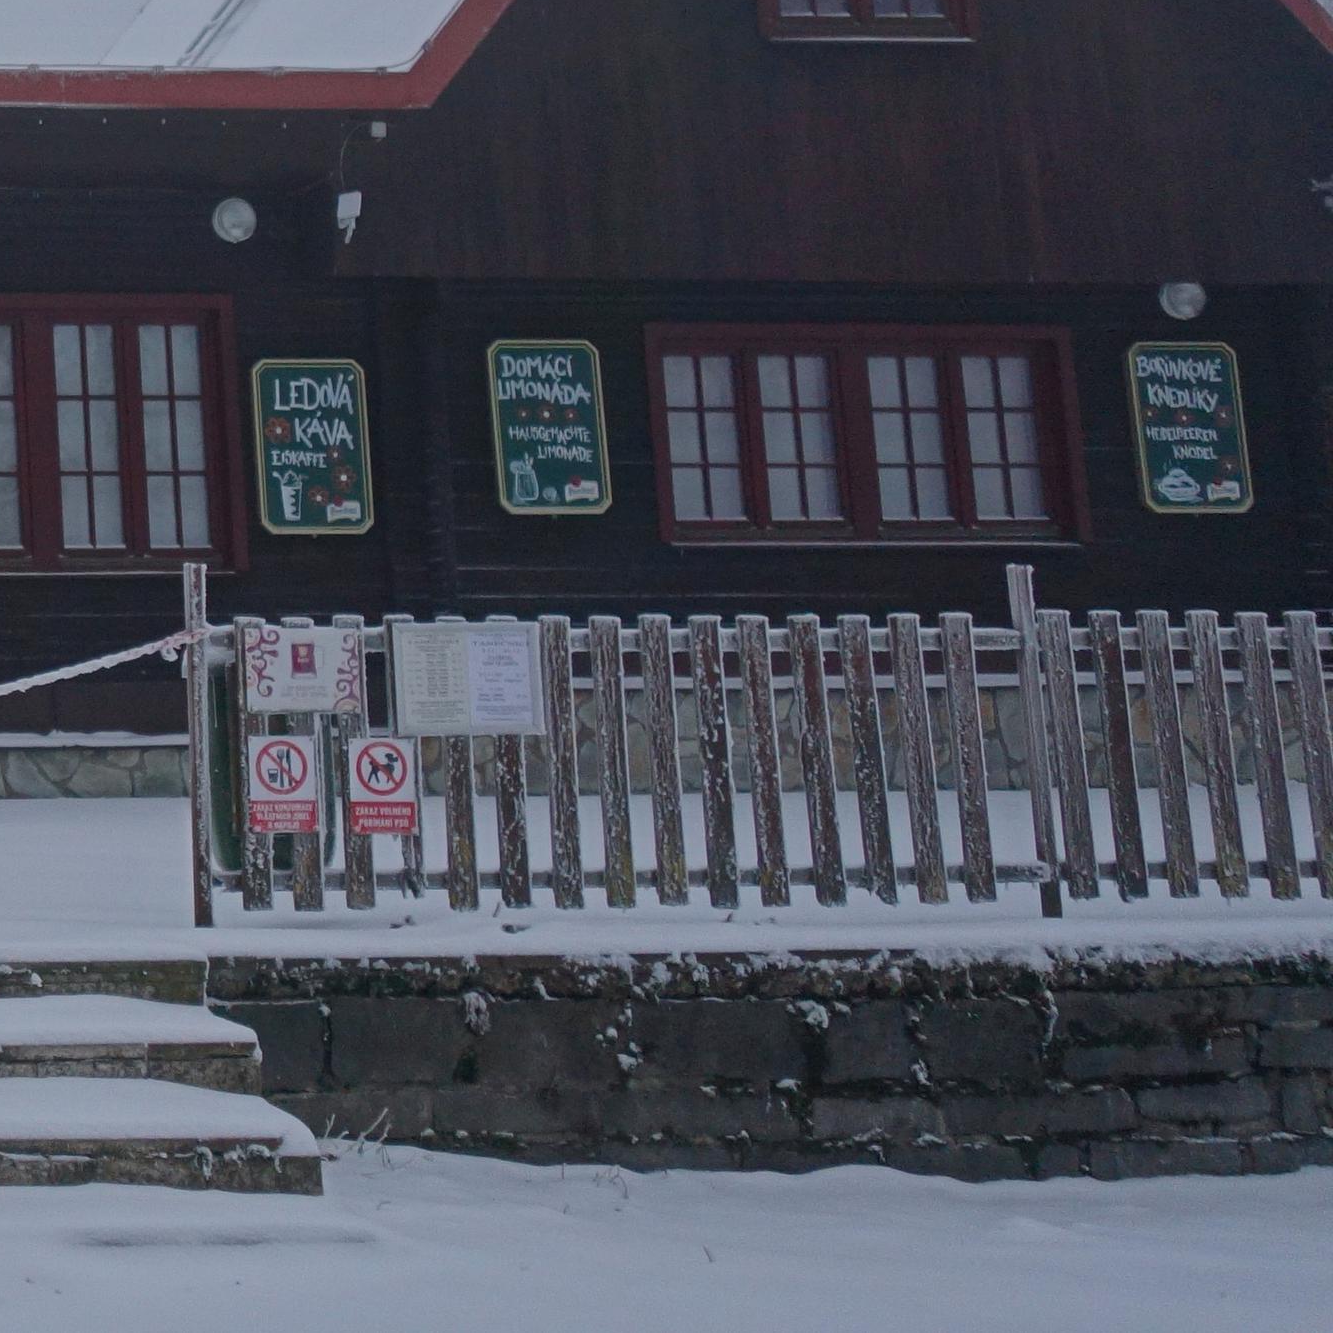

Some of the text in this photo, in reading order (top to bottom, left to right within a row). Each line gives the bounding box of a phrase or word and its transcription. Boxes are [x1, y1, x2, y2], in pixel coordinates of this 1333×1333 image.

[500, 353, 573, 379] DOMÁCÍ
[274, 373, 355, 415] LEDOVÁ
[497, 377, 591, 406] LIMONÁDA
[1146, 382, 1219, 413] KNEDLÍKY
[294, 411, 355, 450] KÁVA
[537, 445, 593, 463] LIMONADE
